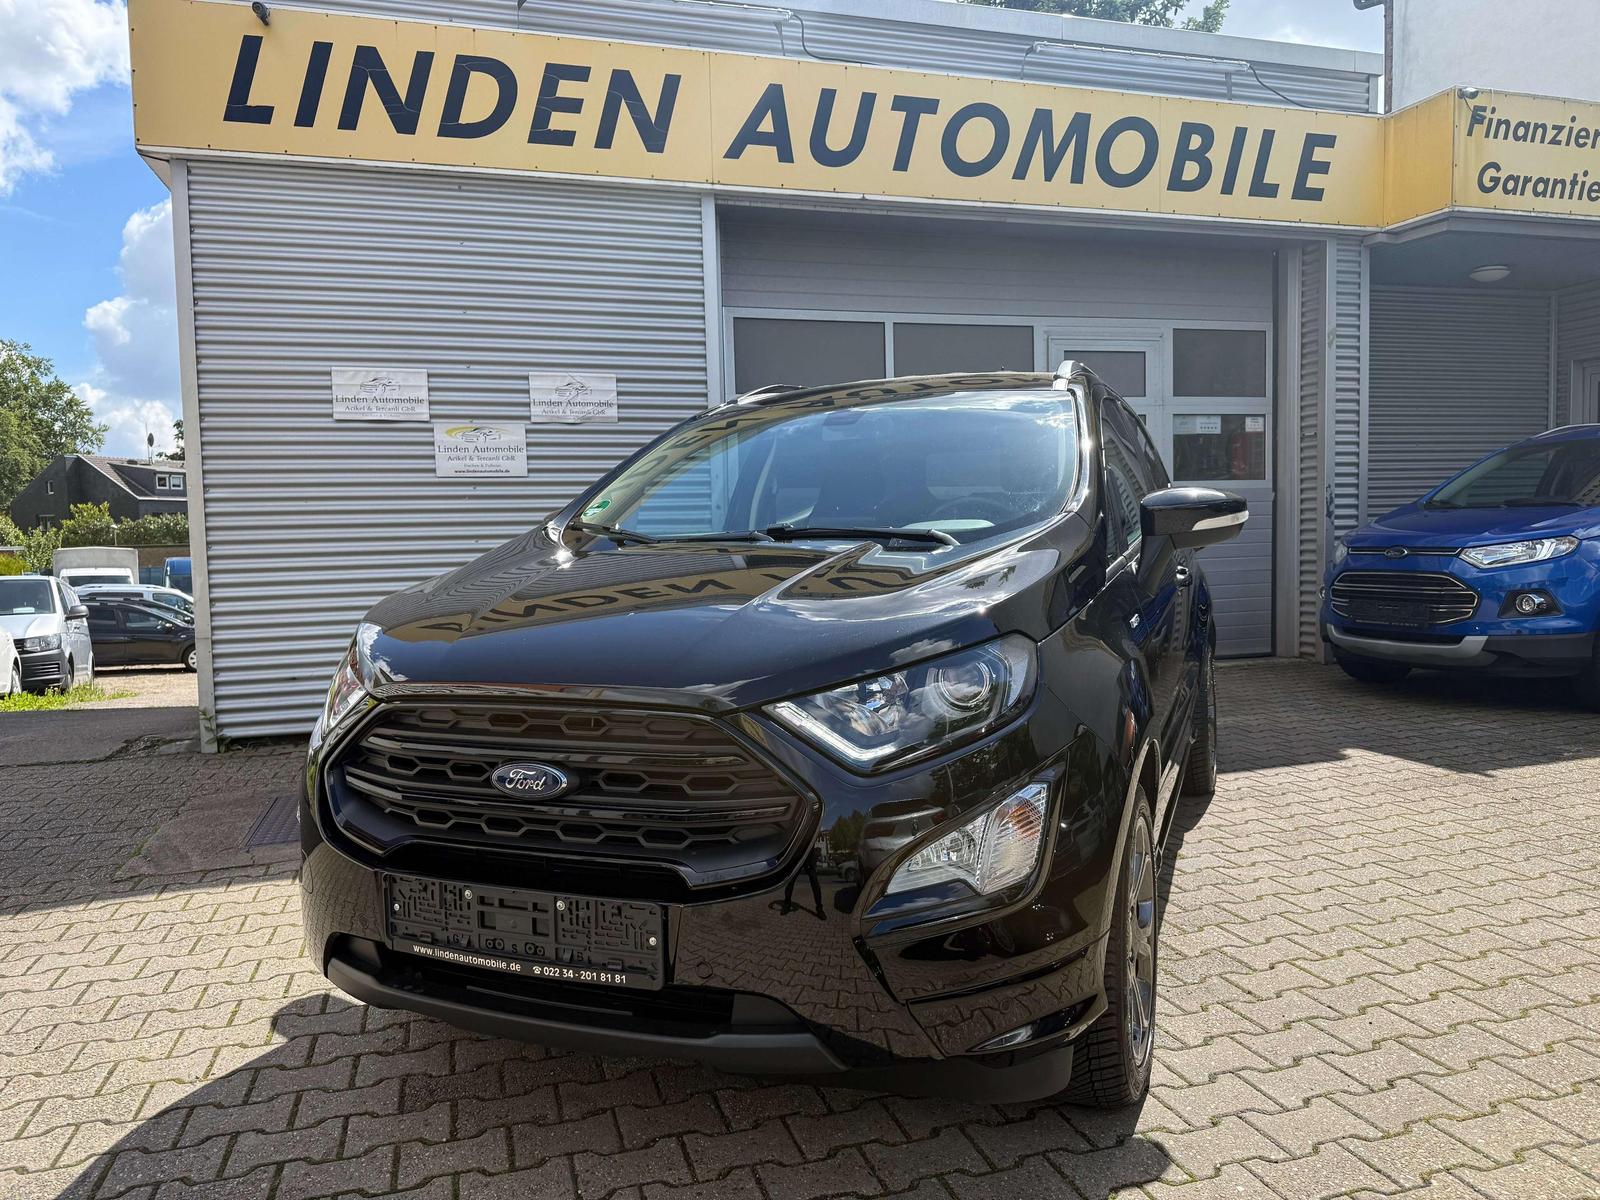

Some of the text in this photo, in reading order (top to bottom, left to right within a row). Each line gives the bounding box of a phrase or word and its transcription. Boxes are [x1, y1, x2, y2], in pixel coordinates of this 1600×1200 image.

[223, 34, 1338, 202] LINDEN AUTOMOBILE
[1477, 161, 1600, 202] Garantie
[335, 394, 425, 405] Linden Automobile
[533, 398, 614, 408] Linden Automobile
[438, 445, 524, 454] Linden Automobile
[505, 768, 546, 790] Ford
[412, 944, 522, 972] www.lindenautomobile.de
[543, 966, 560, 977] 022
[600, 972, 612, 983] 81
[614, 974, 626, 984] 81
